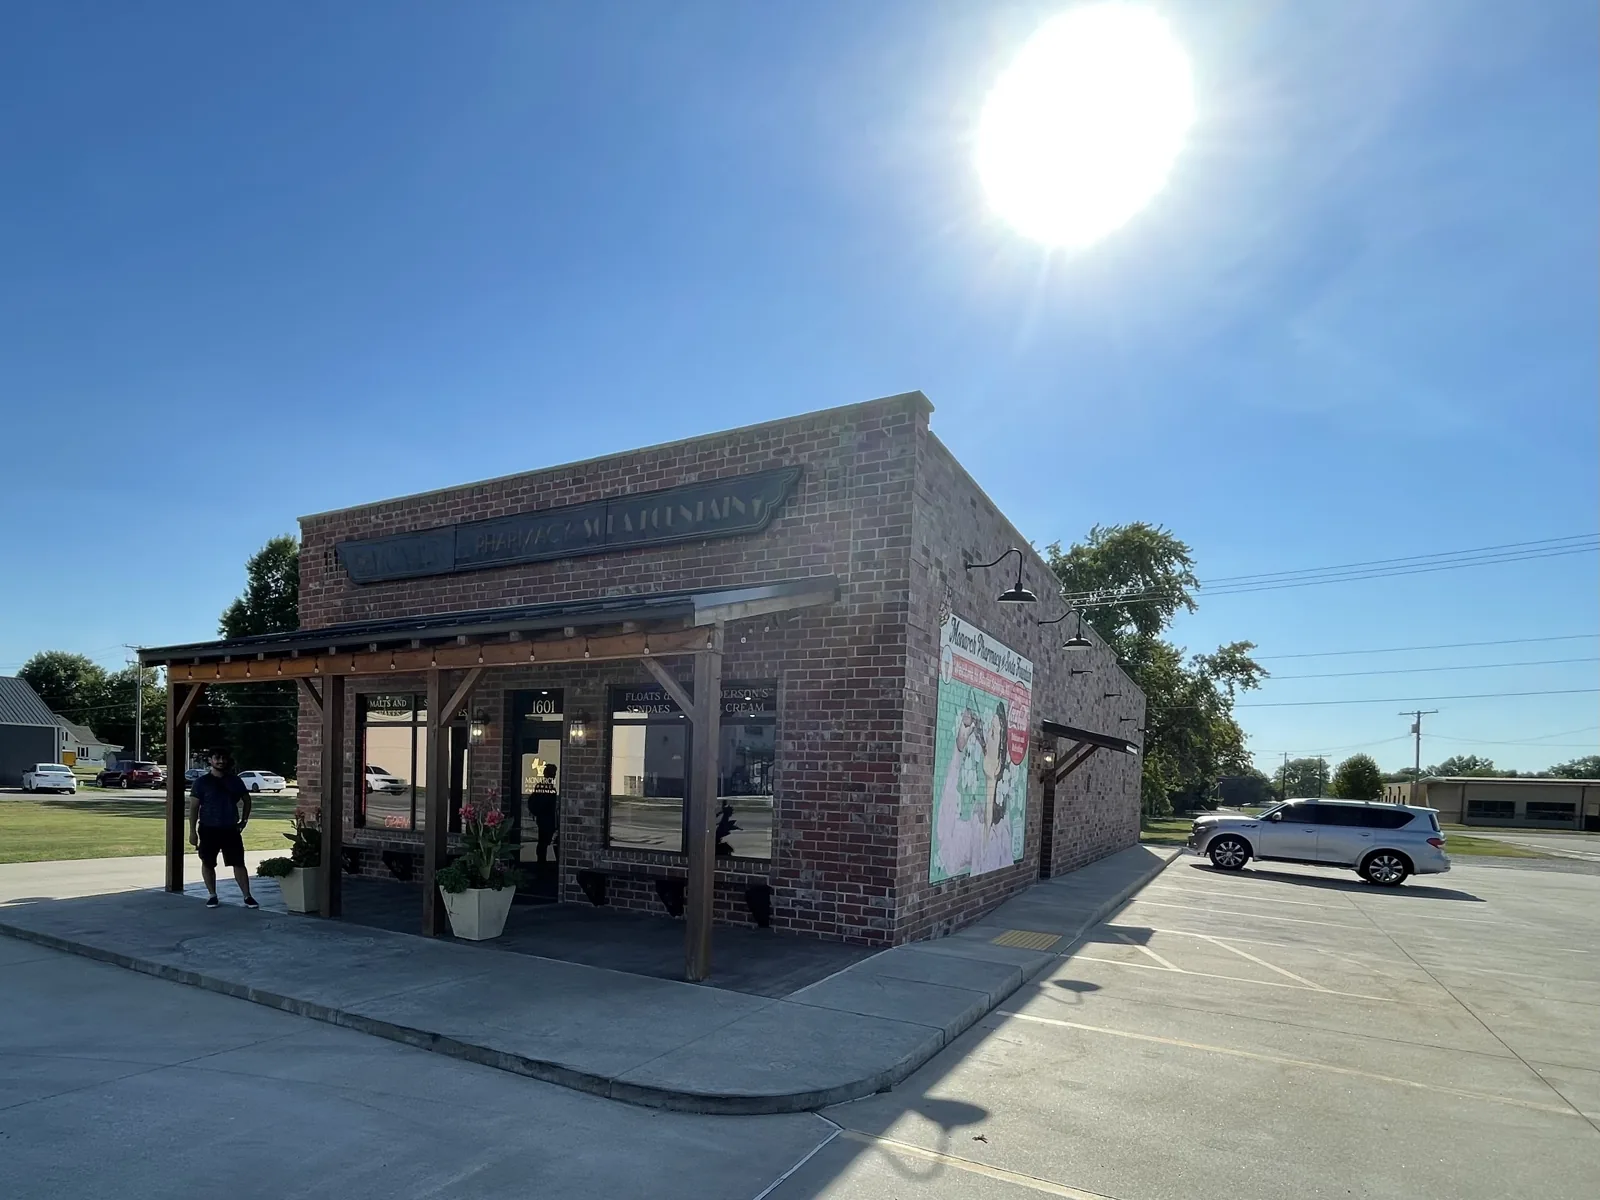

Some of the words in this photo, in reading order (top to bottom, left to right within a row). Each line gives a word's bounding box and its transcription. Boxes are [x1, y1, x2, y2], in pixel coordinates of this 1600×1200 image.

[624, 691, 661, 702] FLOATS
[369, 699, 392, 708] MALTS
[392, 699, 408, 708] AND
[532, 699, 556, 714] 1601
[626, 704, 671, 714] SUNDAES
[725, 702, 765, 713] CREAM
[384, 814, 411, 830] OPEN
